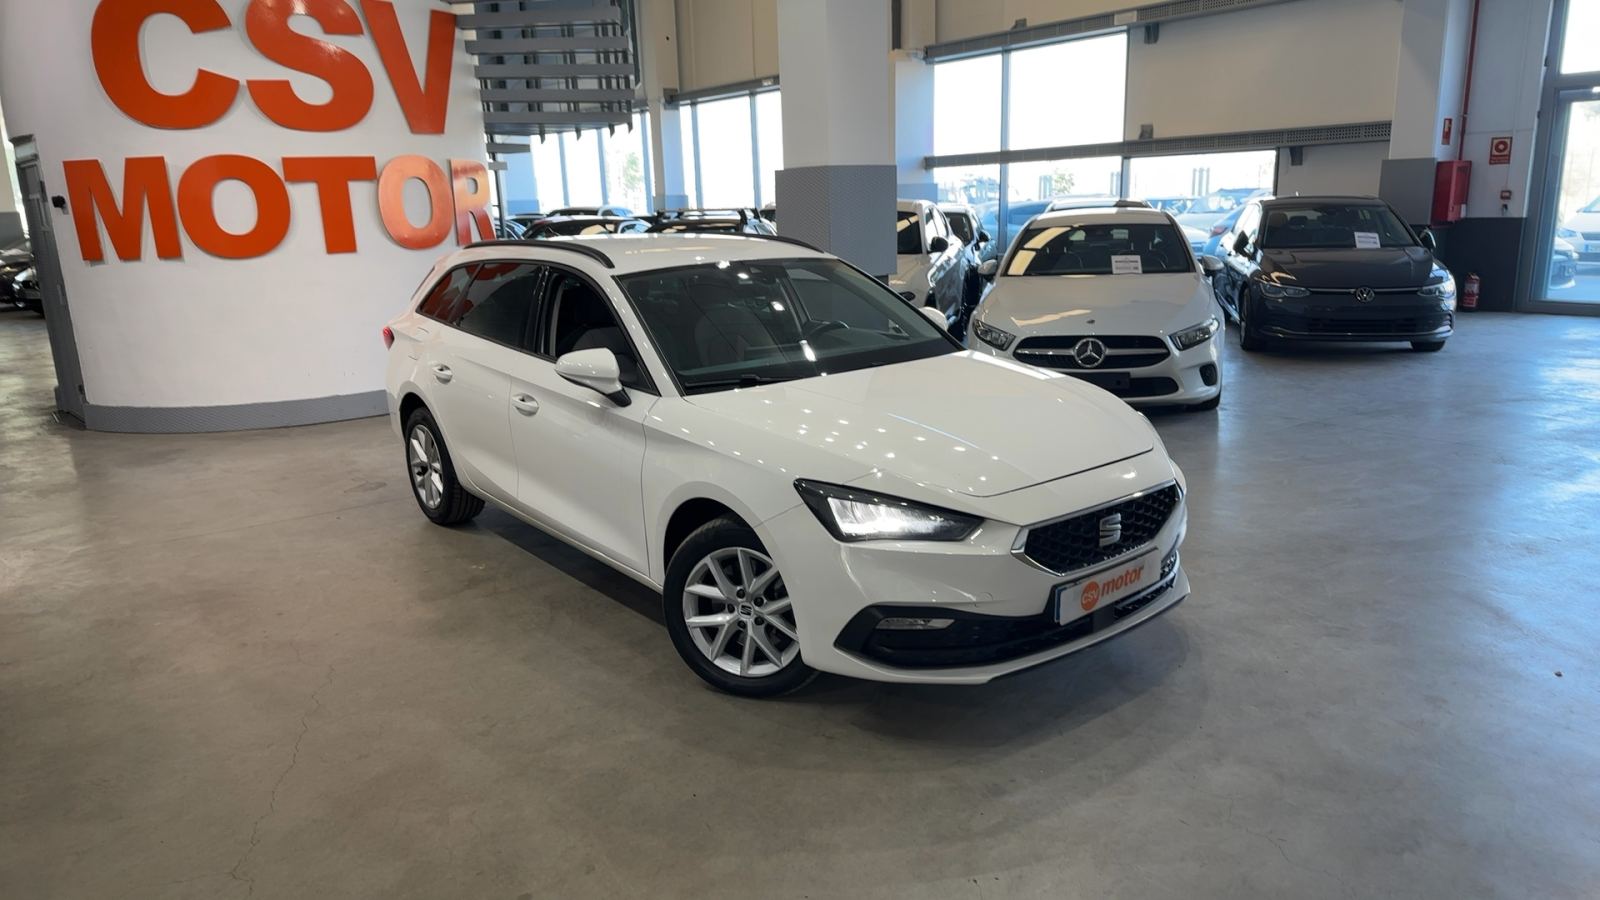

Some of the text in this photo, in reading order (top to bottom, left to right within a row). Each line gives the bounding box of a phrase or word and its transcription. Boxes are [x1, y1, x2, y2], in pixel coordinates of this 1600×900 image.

[91, 0, 457, 135] CSV
[63, 154, 496, 262] MOTOR
[1101, 565, 1144, 598] motor
